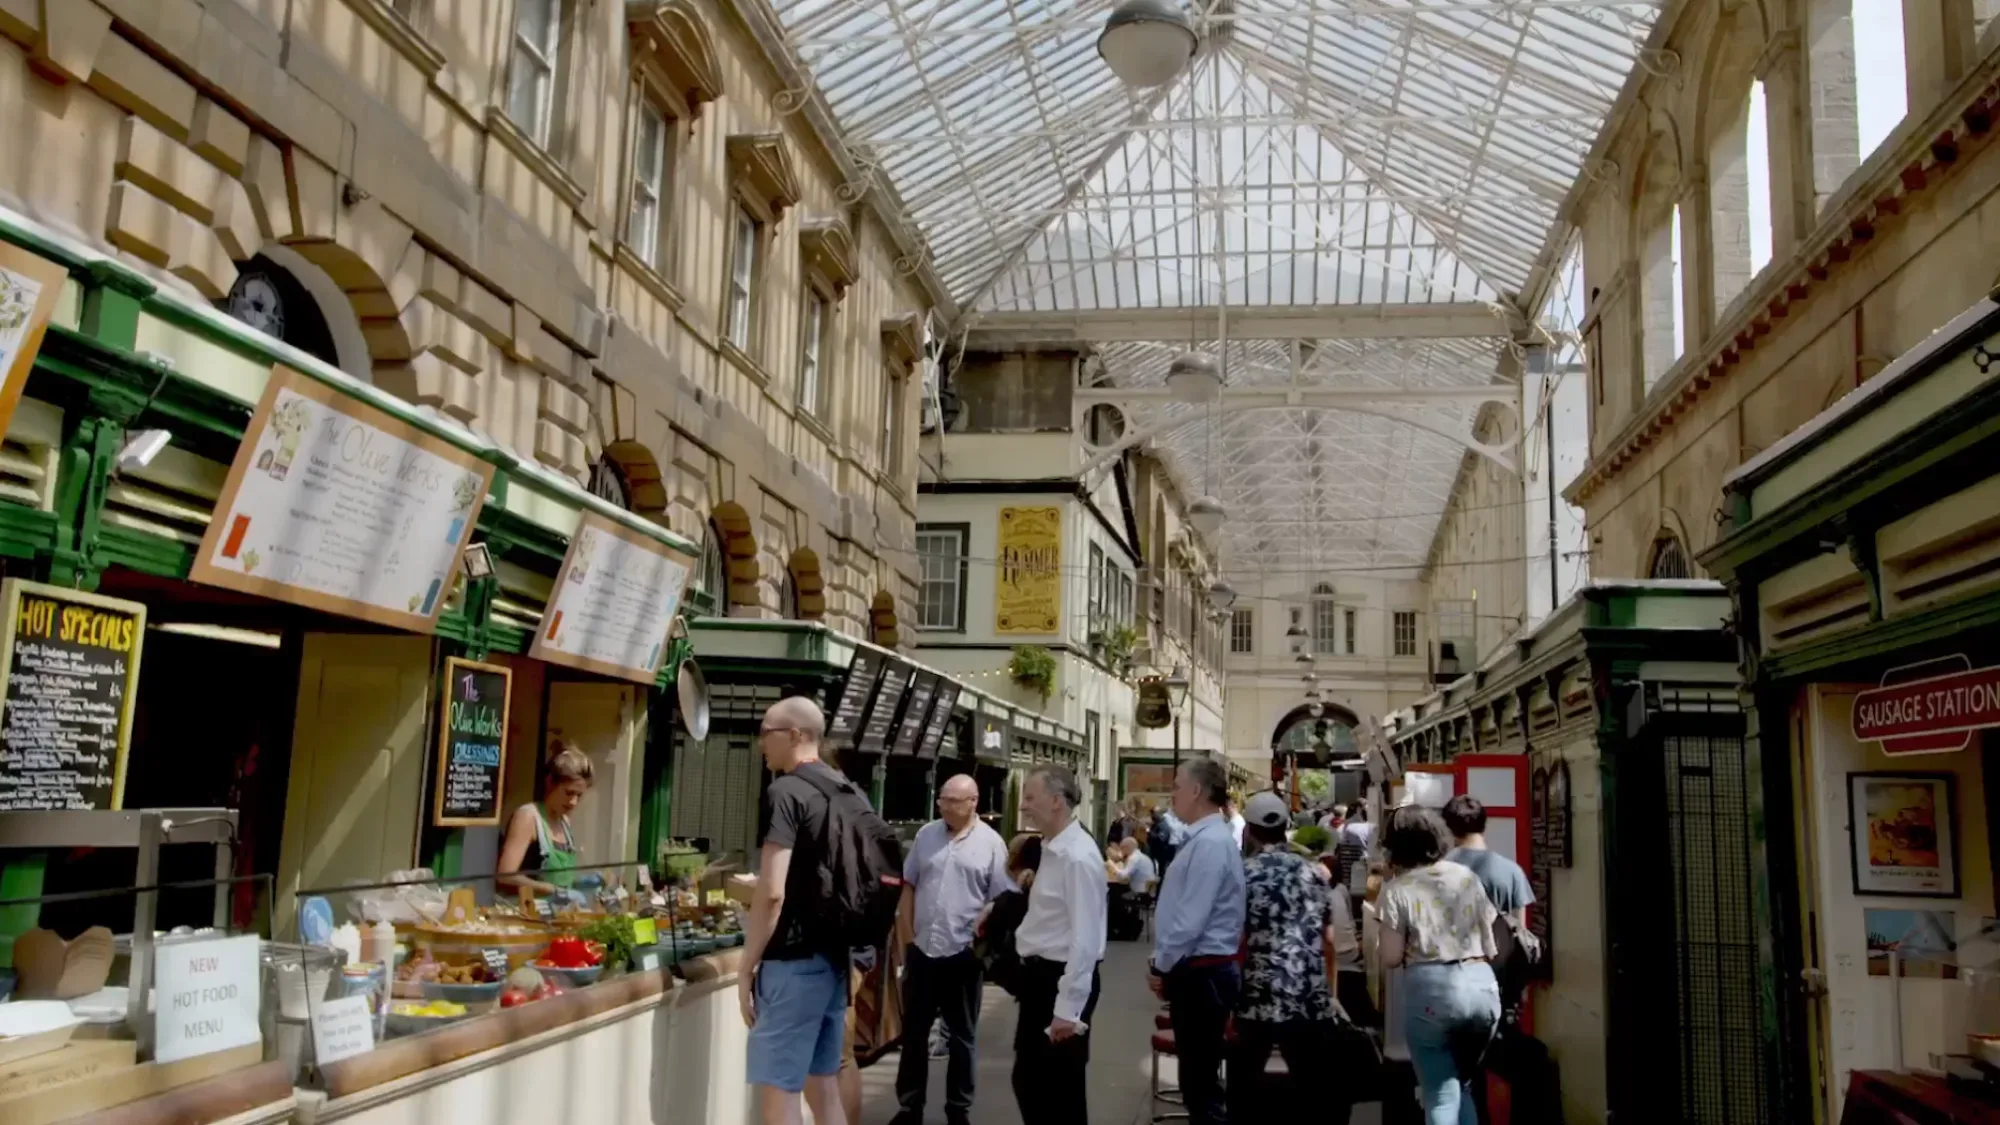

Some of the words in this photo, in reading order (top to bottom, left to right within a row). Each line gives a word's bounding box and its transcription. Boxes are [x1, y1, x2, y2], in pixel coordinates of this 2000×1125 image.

[342, 424, 391, 475] Olive
[17, 597, 56, 639] HOT
[60, 606, 132, 651] SPECIALS
[462, 673, 481, 702] The
[450, 701, 473, 733] Olive
[474, 704, 502, 738] Works
[1859, 694, 1922, 729] SAUSAGE
[1926, 680, 2000, 719] STATION
[189, 956, 219, 975] NEW
[173, 990, 198, 1011] HOT
[202, 984, 238, 1003] FOOD
[184, 1017, 223, 1039] MENU
